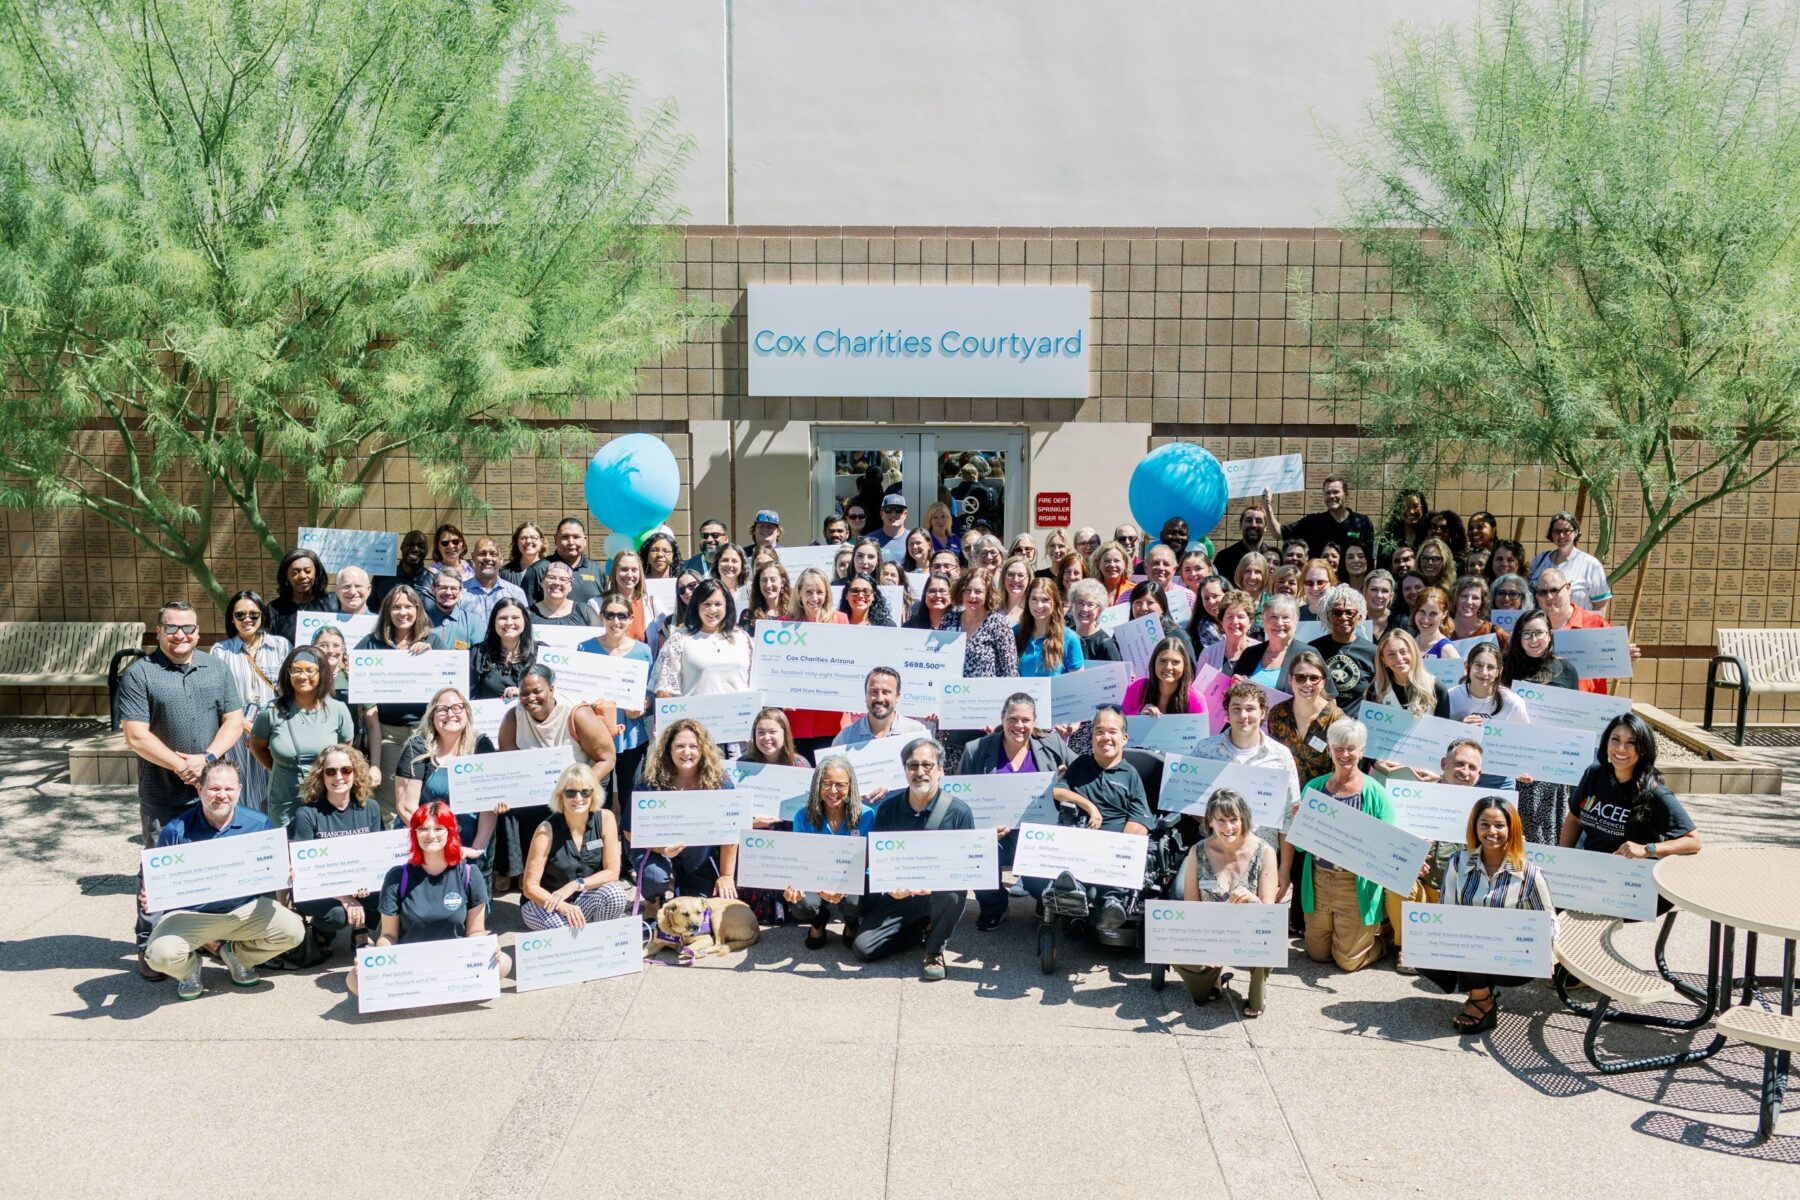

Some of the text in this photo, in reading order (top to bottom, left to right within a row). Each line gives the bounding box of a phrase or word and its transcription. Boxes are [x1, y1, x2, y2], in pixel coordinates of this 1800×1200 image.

[755, 328, 1083, 359] Cox Charities Courtyard
[1100, 614, 1118, 624] OX
[762, 629, 808, 646] COX
[355, 657, 383, 665] COX
[542, 653, 569, 665] COX
[800, 655, 827, 663] Charities
[944, 685, 969, 693] COX
[1516, 688, 1544, 701] COX
[903, 692, 936, 701] Charities
[661, 703, 686, 713] COX
[1364, 708, 1393, 724] COX
[1482, 726, 1503, 736] OX
[453, 762, 483, 774] COX
[1169, 761, 1198, 774] COX
[943, 782, 971, 793] COX
[1392, 787, 1421, 799] COX
[638, 799, 666, 809] COX
[1307, 797, 1338, 818] COX
[1590, 801, 1631, 823] ACEE
[1599, 819, 1625, 829] COUNCIL
[316, 826, 371, 838] CHANGEMAKER
[1025, 830, 1055, 841] COX
[1596, 825, 1625, 837] EDUCATION
[745, 837, 774, 848] COX
[875, 840, 905, 850] COX
[296, 846, 329, 860] COX
[1525, 850, 1556, 864] COX
[149, 852, 184, 868] COX
[1152, 909, 1184, 920] COX
[1408, 911, 1442, 924] COX
[522, 937, 552, 951] COX
[364, 953, 397, 967] COX
